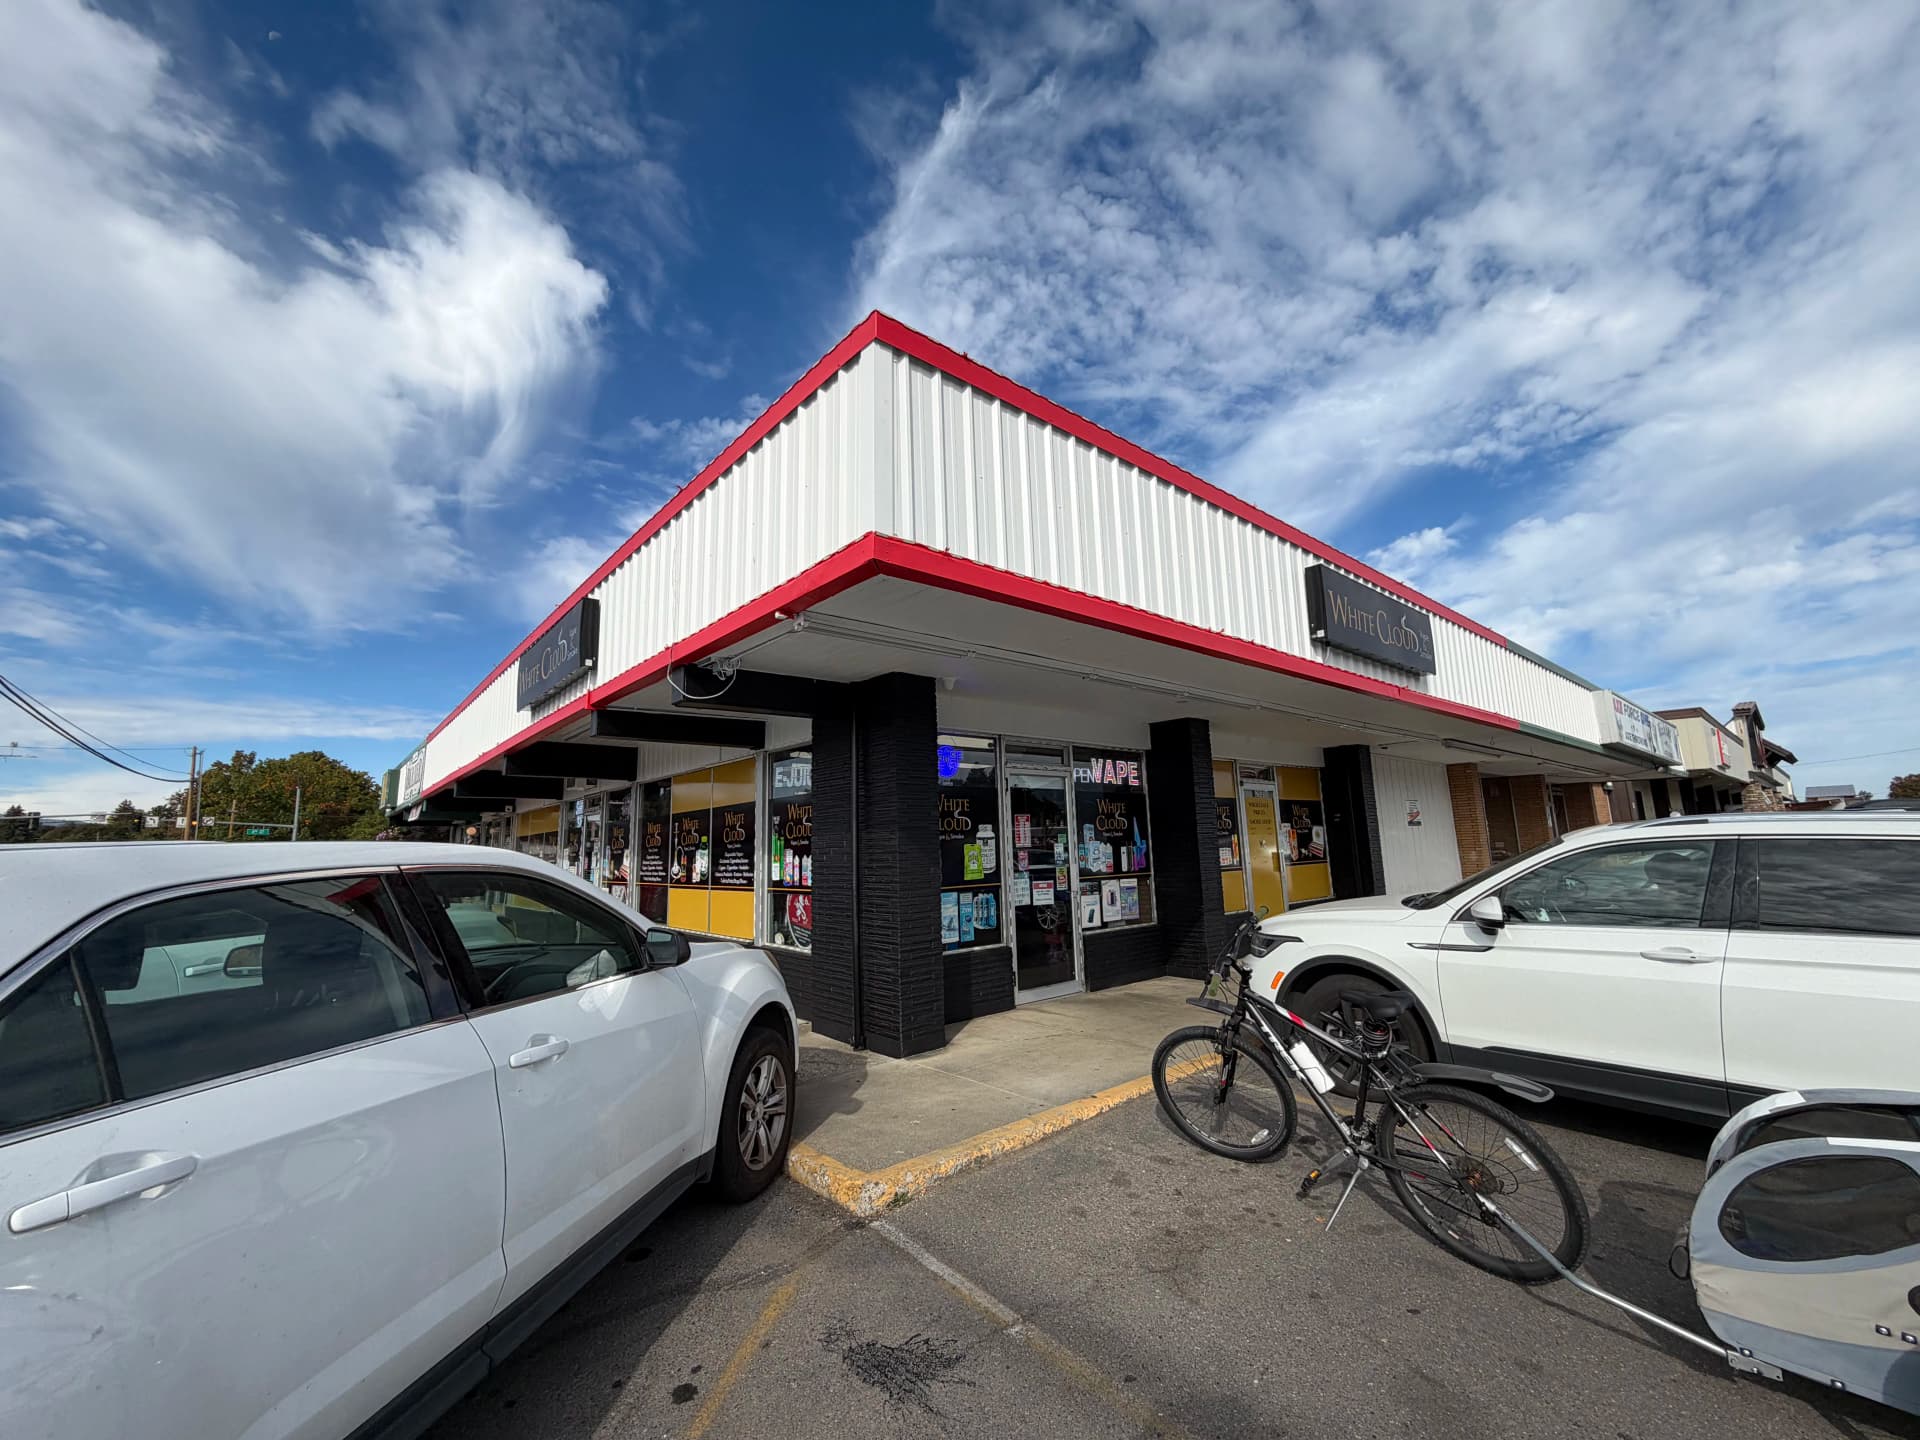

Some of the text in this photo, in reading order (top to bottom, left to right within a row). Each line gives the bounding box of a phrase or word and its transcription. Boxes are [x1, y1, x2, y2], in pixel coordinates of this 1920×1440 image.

[1328, 589, 1375, 636] WHITE
[1376, 610, 1419, 653] CLOUD
[1074, 767, 1095, 783] PEN
[1090, 757, 1140, 786] VAPE
[787, 803, 812, 820] WHIT
[1096, 799, 1127, 815] WHITE
[1216, 806, 1231, 816] HITE
[725, 811, 745, 827] WHITE
[939, 810, 971, 831] LOUD
[1096, 811, 1128, 831] CLOUD
[724, 824, 746, 843] CLOUD
